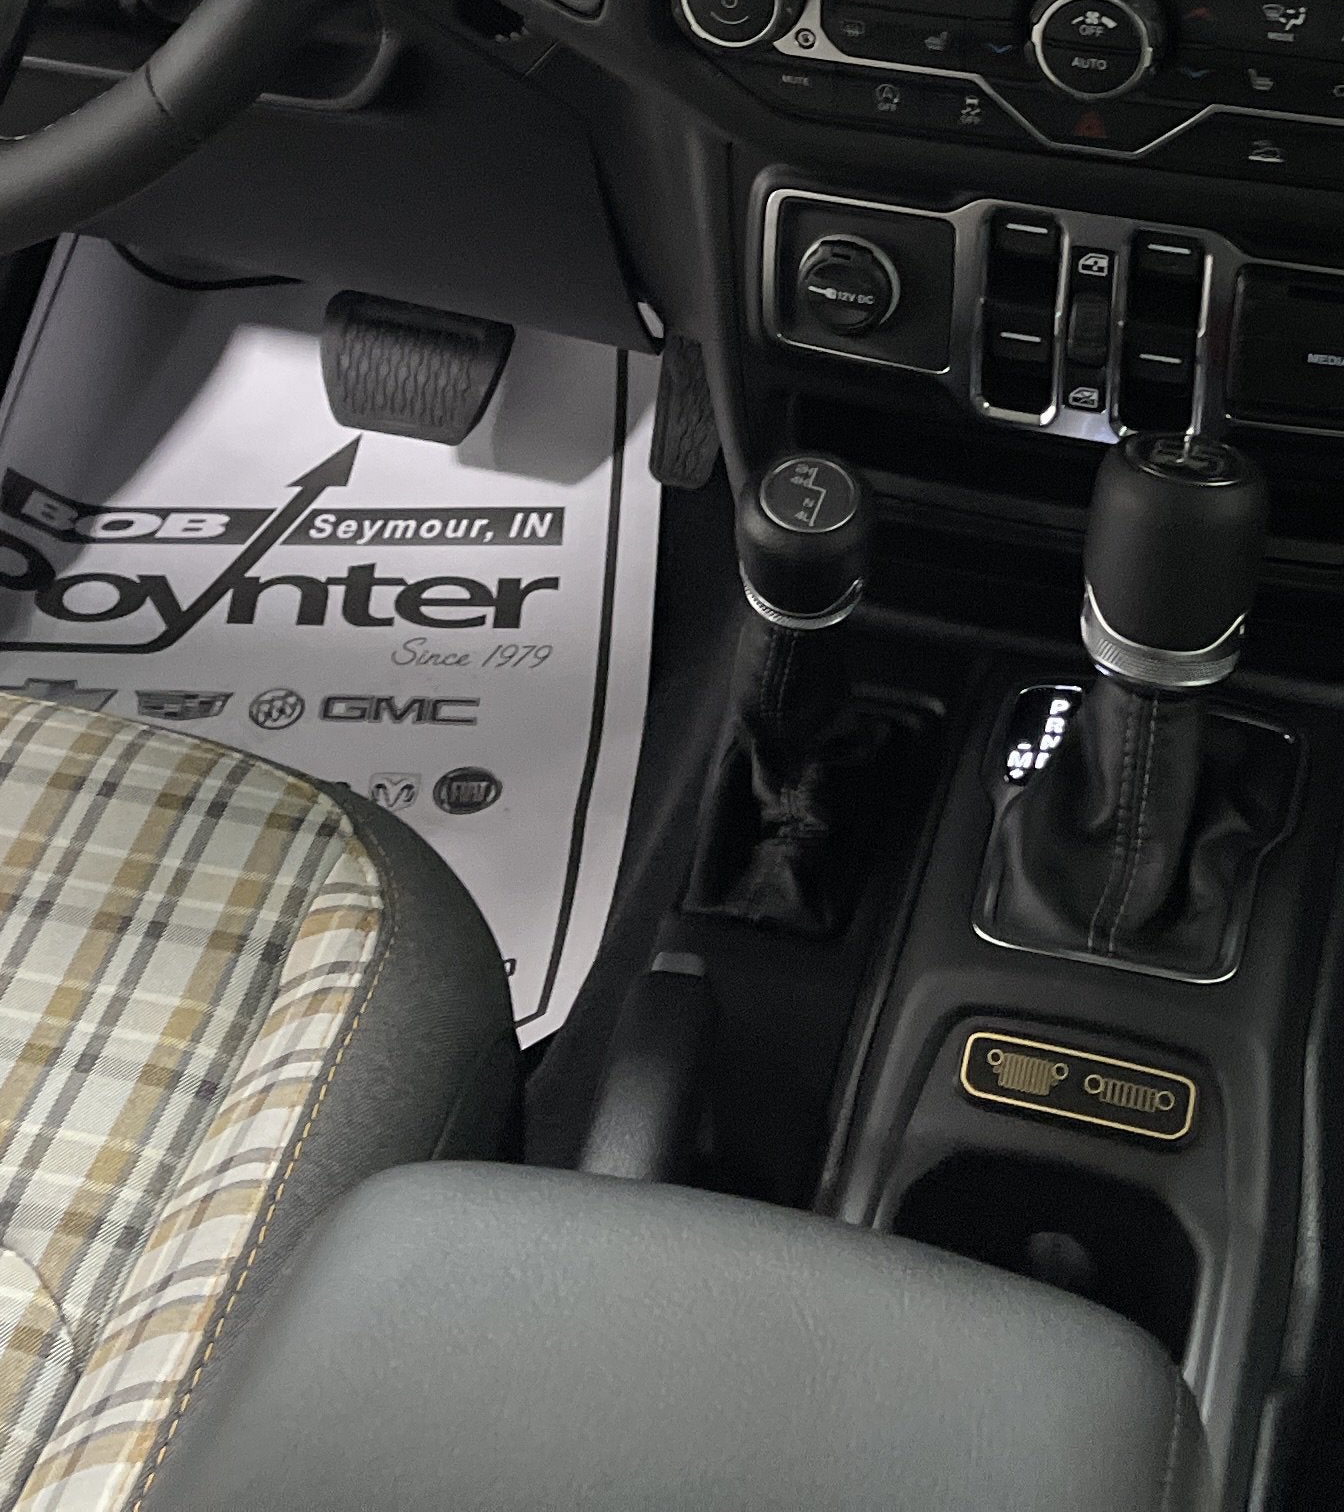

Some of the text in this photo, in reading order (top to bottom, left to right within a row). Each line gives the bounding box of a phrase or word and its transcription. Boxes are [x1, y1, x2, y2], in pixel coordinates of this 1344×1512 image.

[1071, 57, 1107, 70] AUTO
[19, 488, 554, 544] BOB Seymour, IN
[391, 637, 554, 669] Since 1979
[320, 695, 480, 726] GMC
[1049, 699, 1071, 715] P
